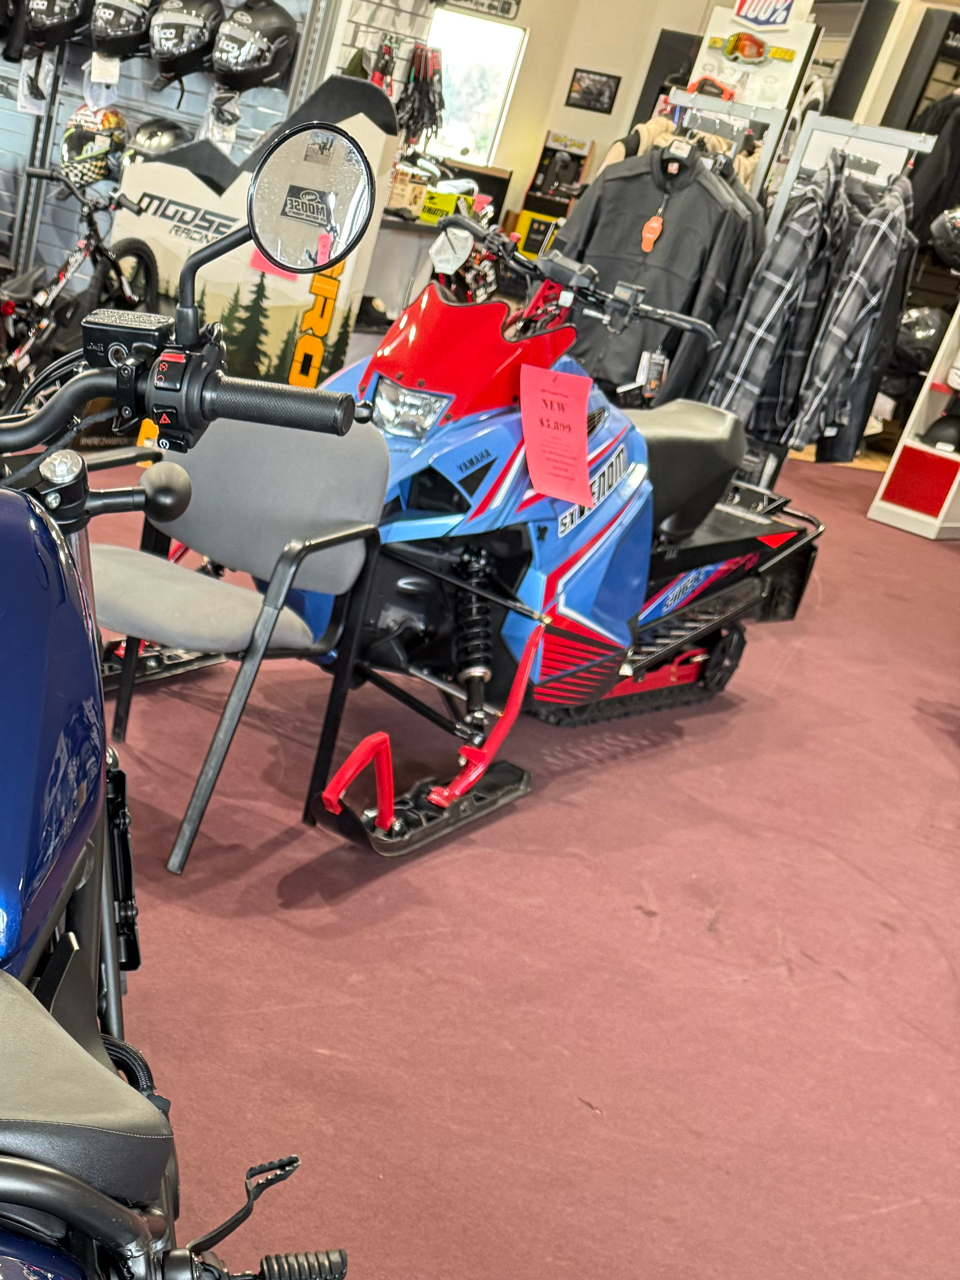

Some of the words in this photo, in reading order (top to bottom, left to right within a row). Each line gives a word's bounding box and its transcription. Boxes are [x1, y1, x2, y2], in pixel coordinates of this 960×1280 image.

[138, 192, 240, 236] MOOSE
[542, 399, 565, 412] NEW
[457, 449, 492, 474] YAMAHA
